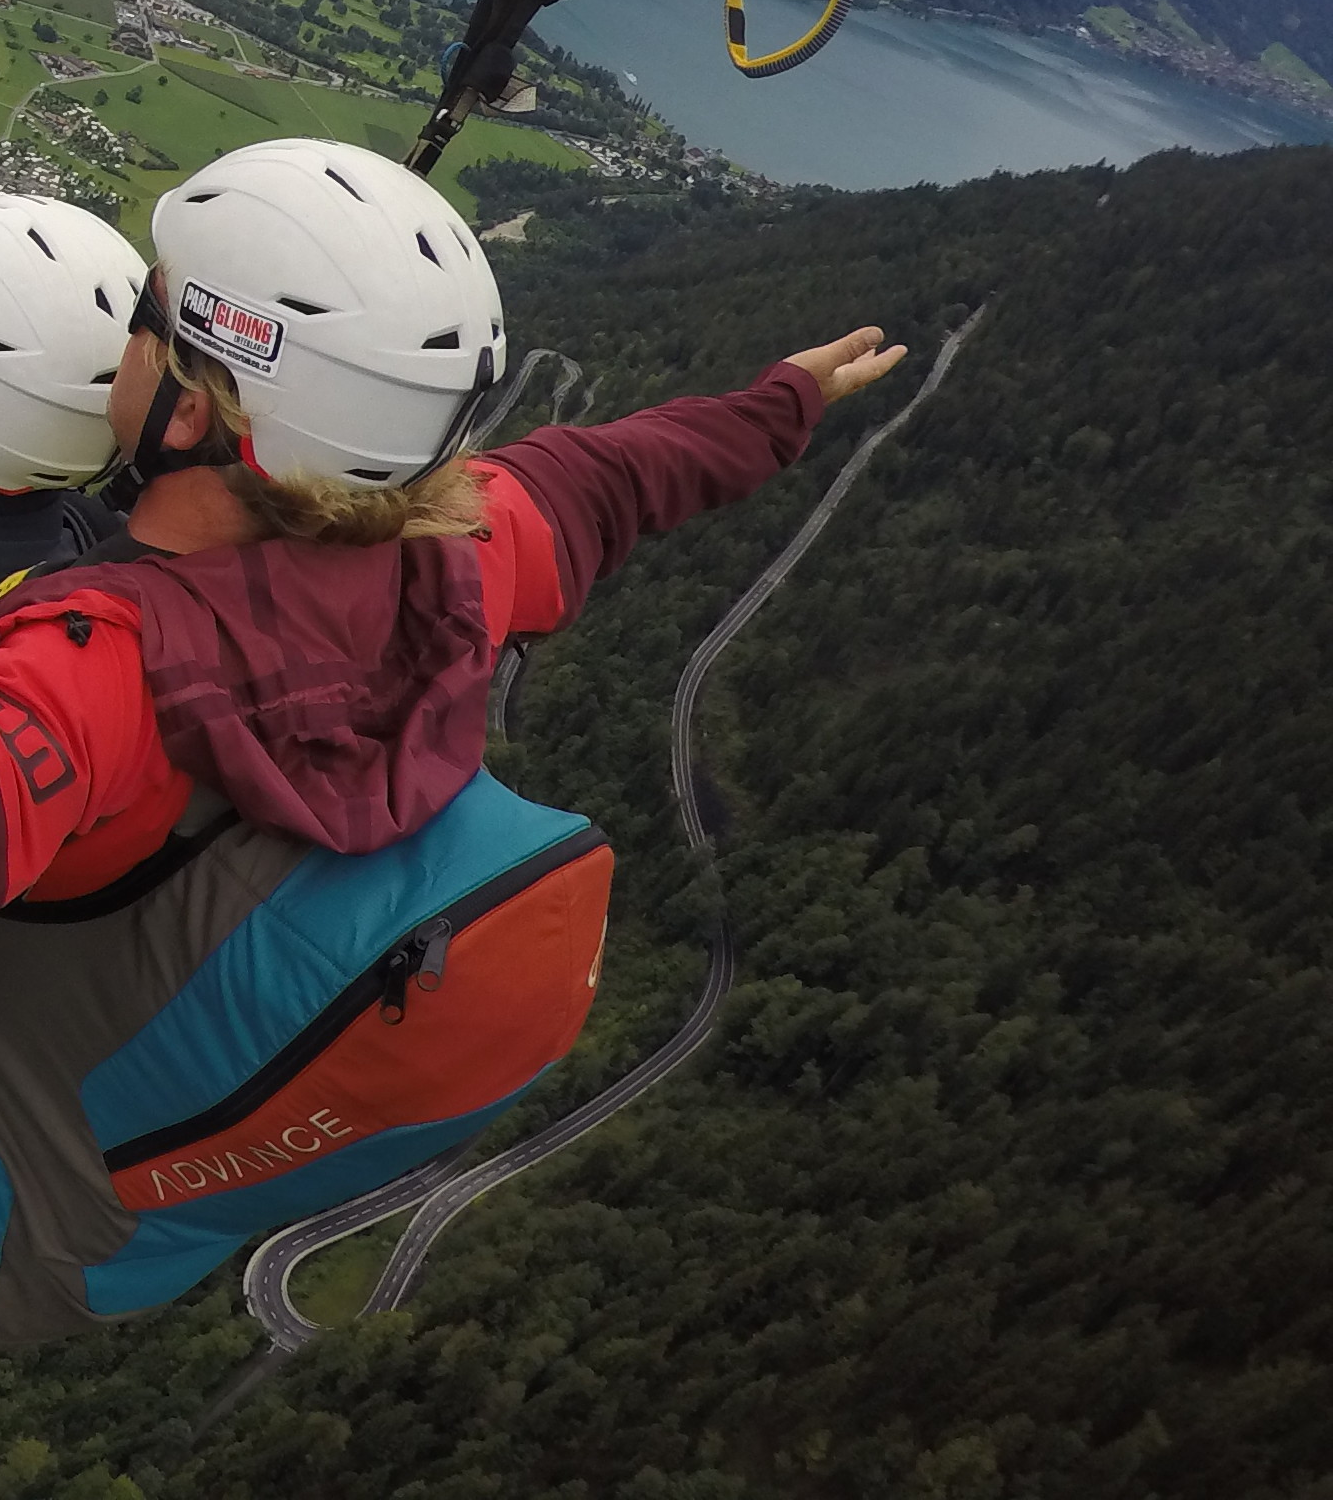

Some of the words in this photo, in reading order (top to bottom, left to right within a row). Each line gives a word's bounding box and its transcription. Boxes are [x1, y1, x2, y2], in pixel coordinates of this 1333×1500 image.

[183, 285, 215, 321] PARA
[215, 302, 273, 346] GLIDING
[150, 1108, 353, 1201] ADVANCE
